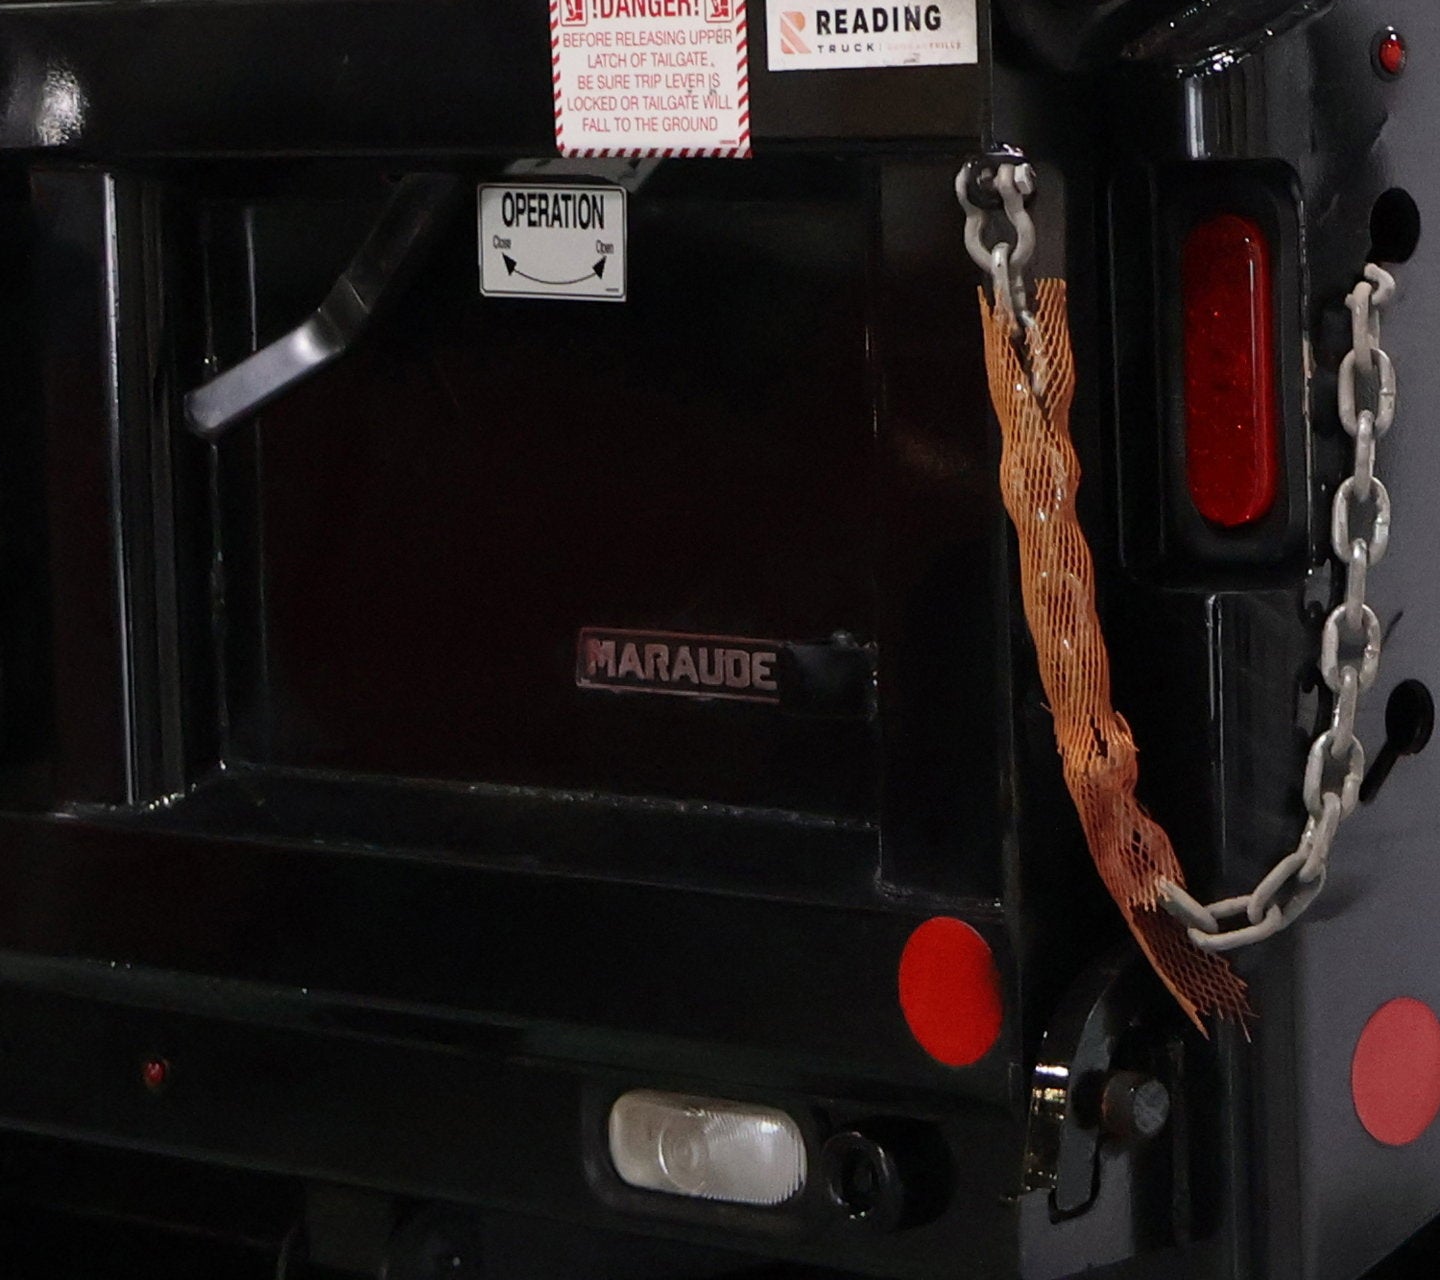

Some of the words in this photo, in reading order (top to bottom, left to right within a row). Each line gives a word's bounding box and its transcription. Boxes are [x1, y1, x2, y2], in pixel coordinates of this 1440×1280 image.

[816, 4, 942, 36] READING
[563, 32, 611, 48] BEFORE
[616, 30, 687, 46] RELEASING
[689, 28, 732, 45] UPPER
[817, 42, 874, 53] TRUCK
[587, 53, 627, 69] LATCH
[630, 52, 647, 67] OF
[577, 74, 593, 90] BE
[597, 74, 630, 90] SURE
[635, 74, 661, 89] TRIP
[665, 73, 705, 88] LEVER
[709, 72, 720, 88] IS
[567, 96, 617, 112] LOCKED
[620, 95, 639, 111] OR
[641, 95, 698, 110] TAILGATE
[702, 94, 732, 110] WILL
[582, 117, 610, 133] FALL
[614, 117, 631, 132] TO
[635, 117, 658, 131] THE
[662, 116, 718, 132] GROUND
[502, 191, 604, 230] OPERATION
[586, 638, 777, 691] MARAUDE
